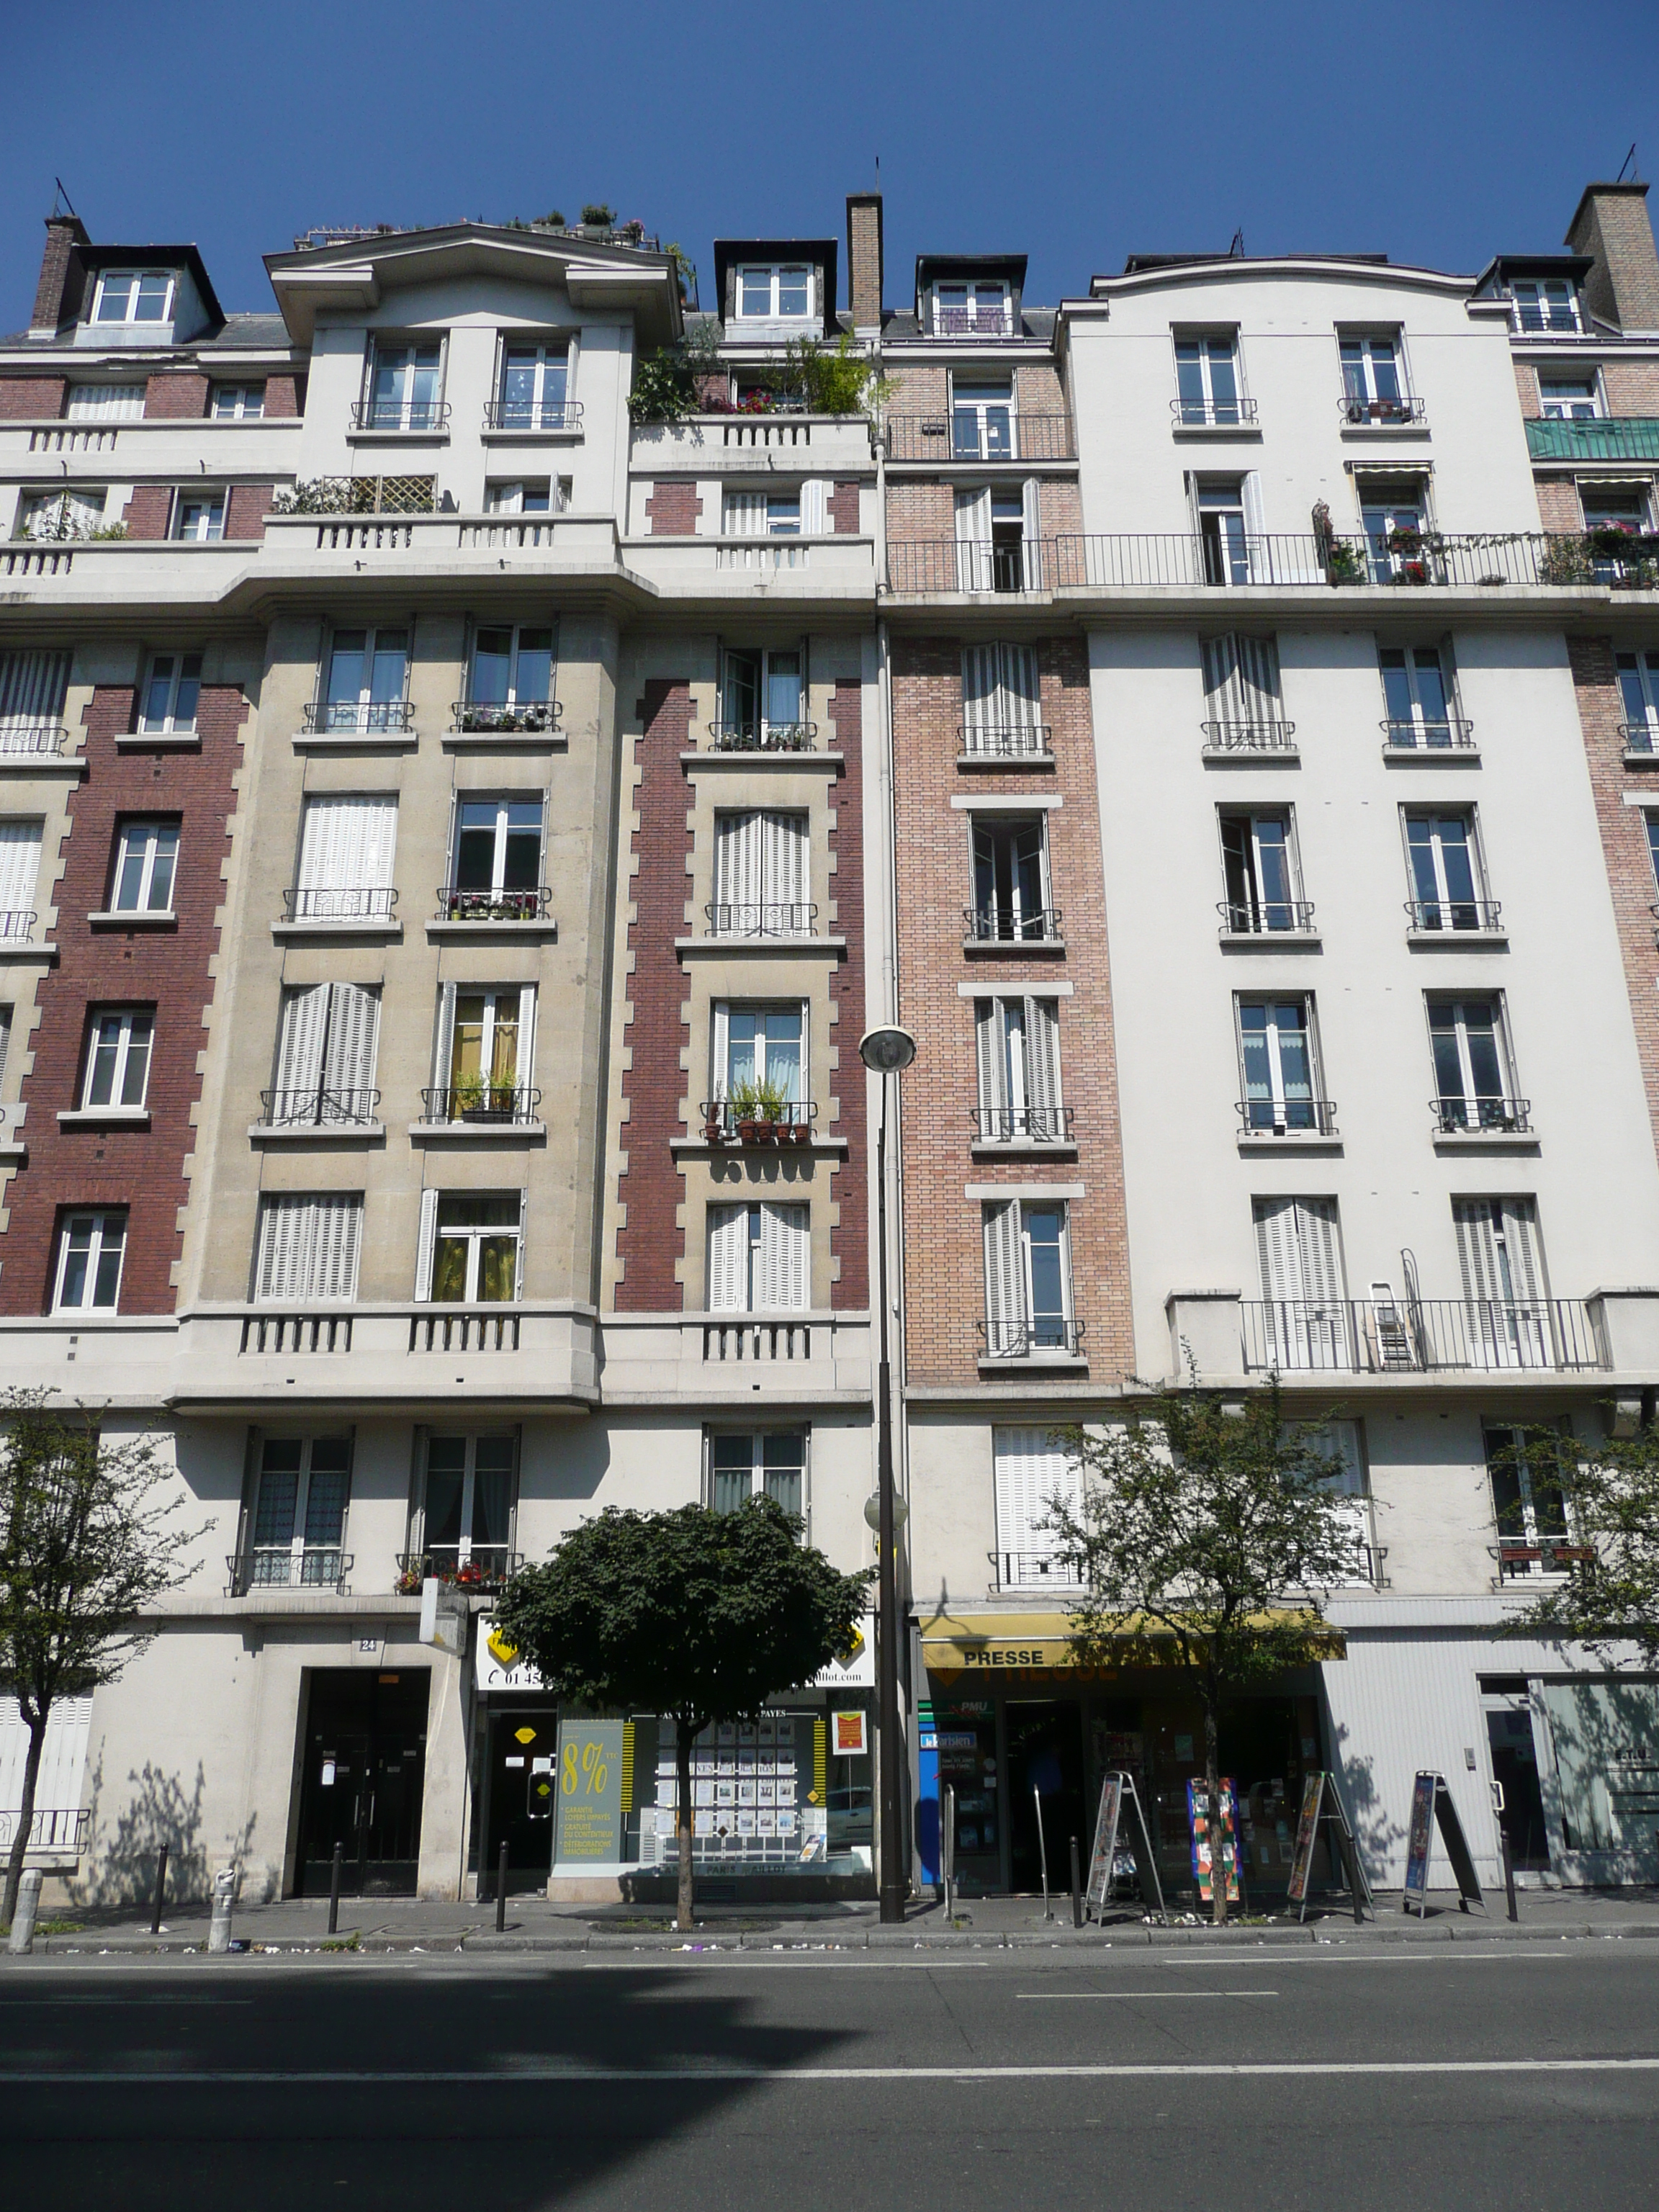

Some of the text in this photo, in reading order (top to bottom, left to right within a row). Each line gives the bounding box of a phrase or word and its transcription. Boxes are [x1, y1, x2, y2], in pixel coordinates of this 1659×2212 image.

[362, 1640, 375, 1650] 24
[963, 1650, 1043, 1665] PRESSE
[505, 1673, 518, 1684] 01
[961, 1701, 988, 1712] PMU
[933, 1735, 971, 1747] Parisien
[1615, 1749, 1651, 1759] E.T.U.
[562, 1743, 608, 1795] 8%
[707, 1865, 736, 1874] PARIS
[742, 1864, 786, 1874] MAILLOT
